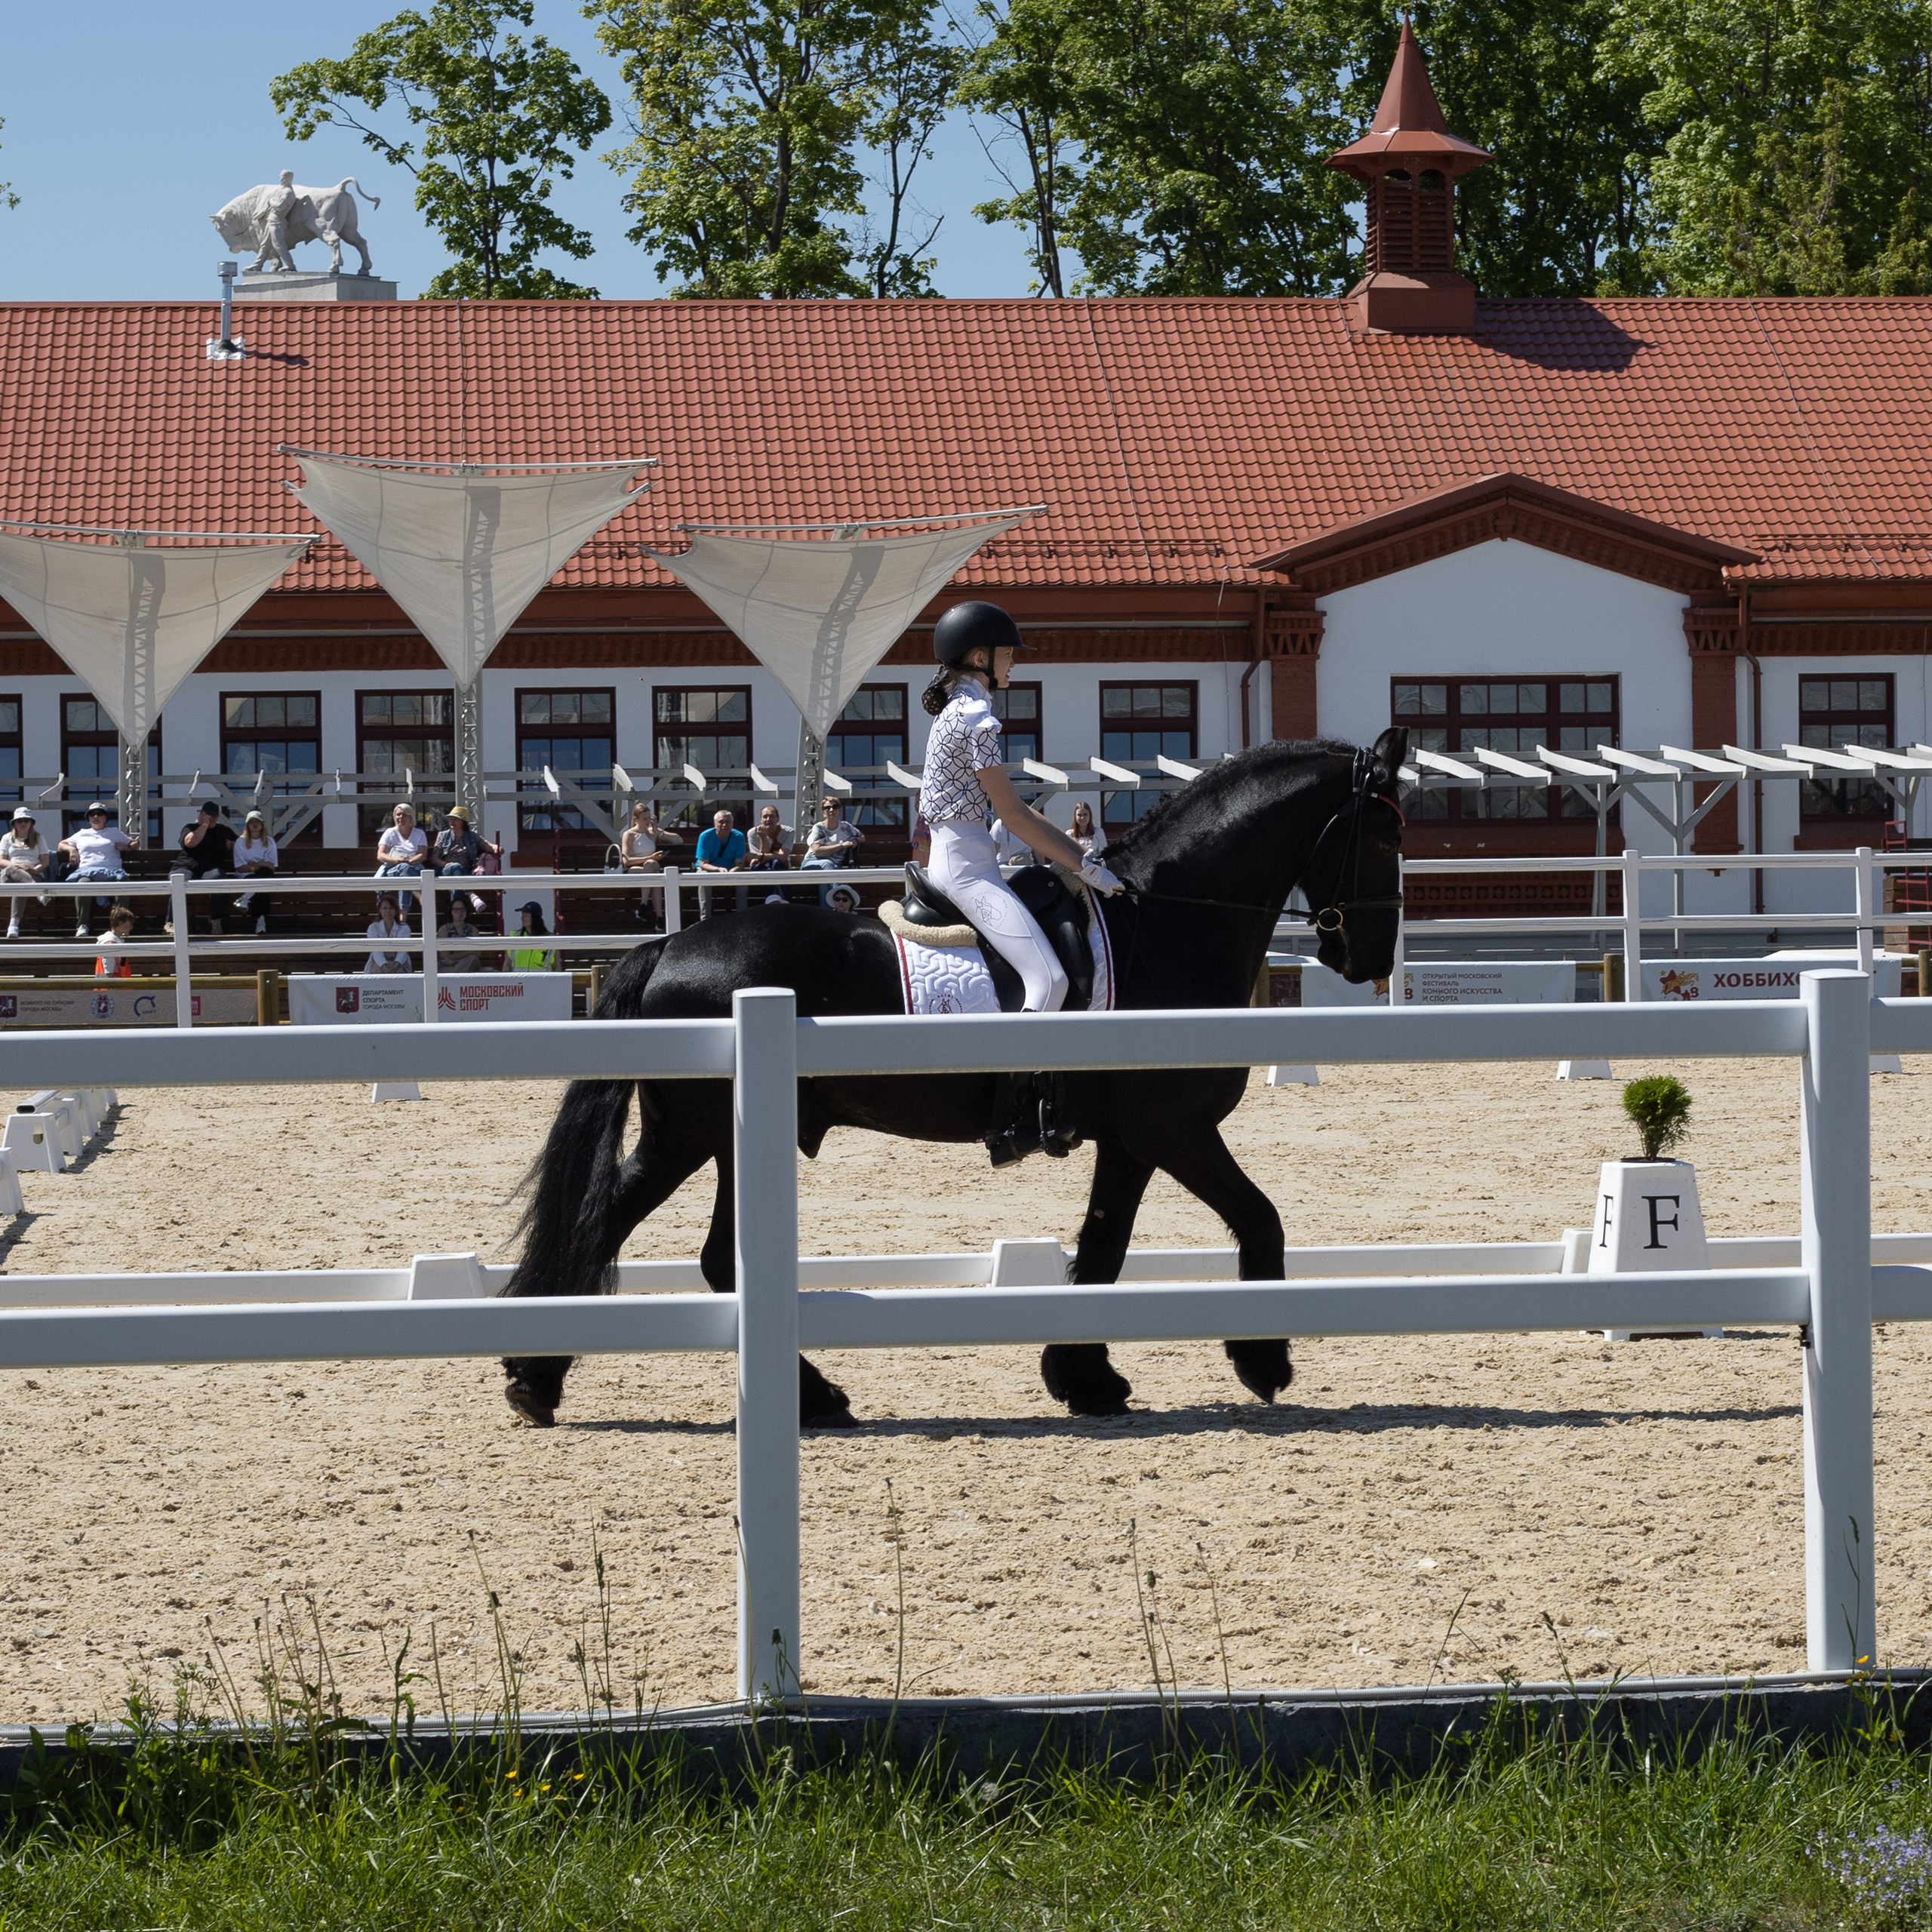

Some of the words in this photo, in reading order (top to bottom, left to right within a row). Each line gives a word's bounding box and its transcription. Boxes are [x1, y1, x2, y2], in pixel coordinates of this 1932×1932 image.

[460, 983, 524, 998] МОСКОВСКИЙ
[460, 998, 490, 1011] СПОРТ
[1641, 1195, 1680, 1249] F
